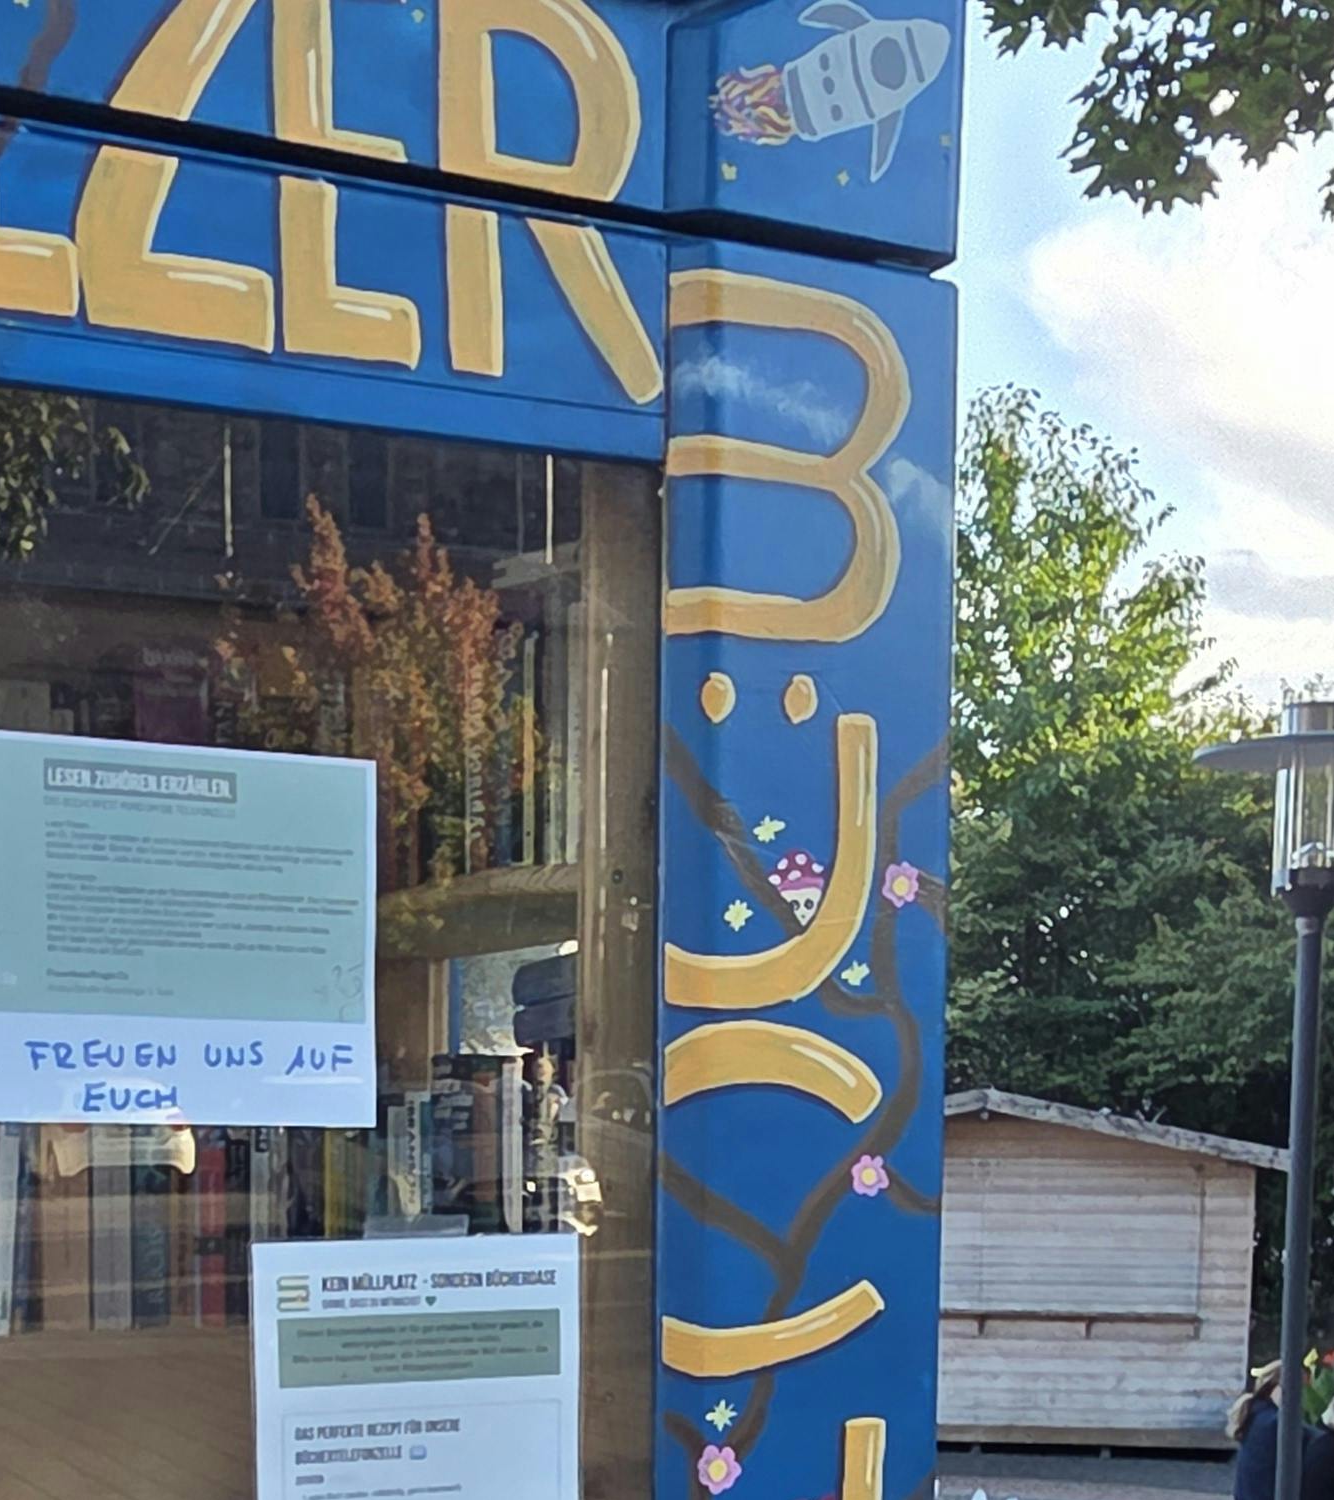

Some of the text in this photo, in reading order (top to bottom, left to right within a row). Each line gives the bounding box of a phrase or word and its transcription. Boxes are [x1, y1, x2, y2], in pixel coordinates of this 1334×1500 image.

[24, 1038, 178, 1073] FREUEN
[204, 1040, 265, 1069] UNS
[284, 1043, 356, 1077] AUF
[80, 1080, 180, 1114] EUCH
[321, 1276, 349, 1292] KEIN
[351, 1272, 418, 1292] MÜLLPLATZ
